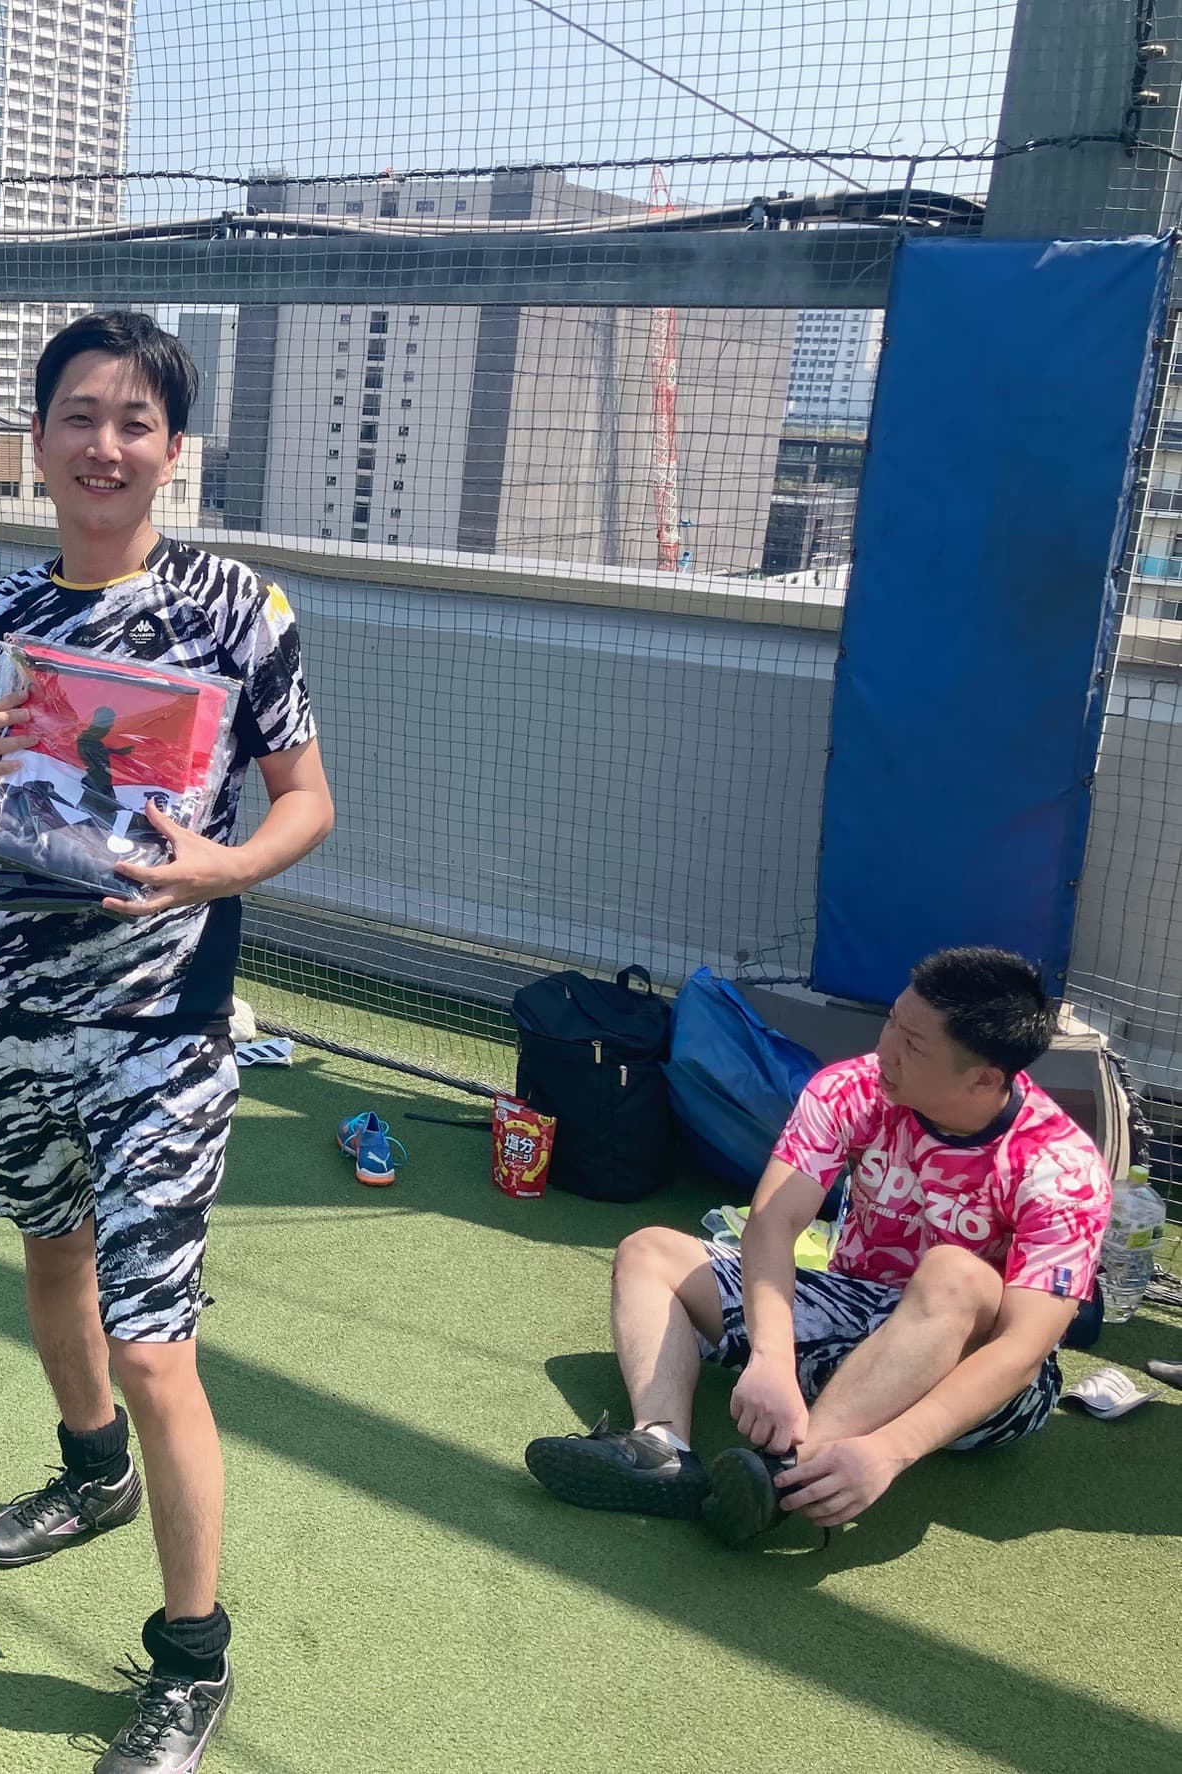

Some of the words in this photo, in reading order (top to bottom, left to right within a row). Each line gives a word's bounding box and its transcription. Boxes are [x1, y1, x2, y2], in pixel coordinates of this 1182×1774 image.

[504, 1132, 536, 1154] 塩分
[503, 1148, 533, 1163] チャージ
